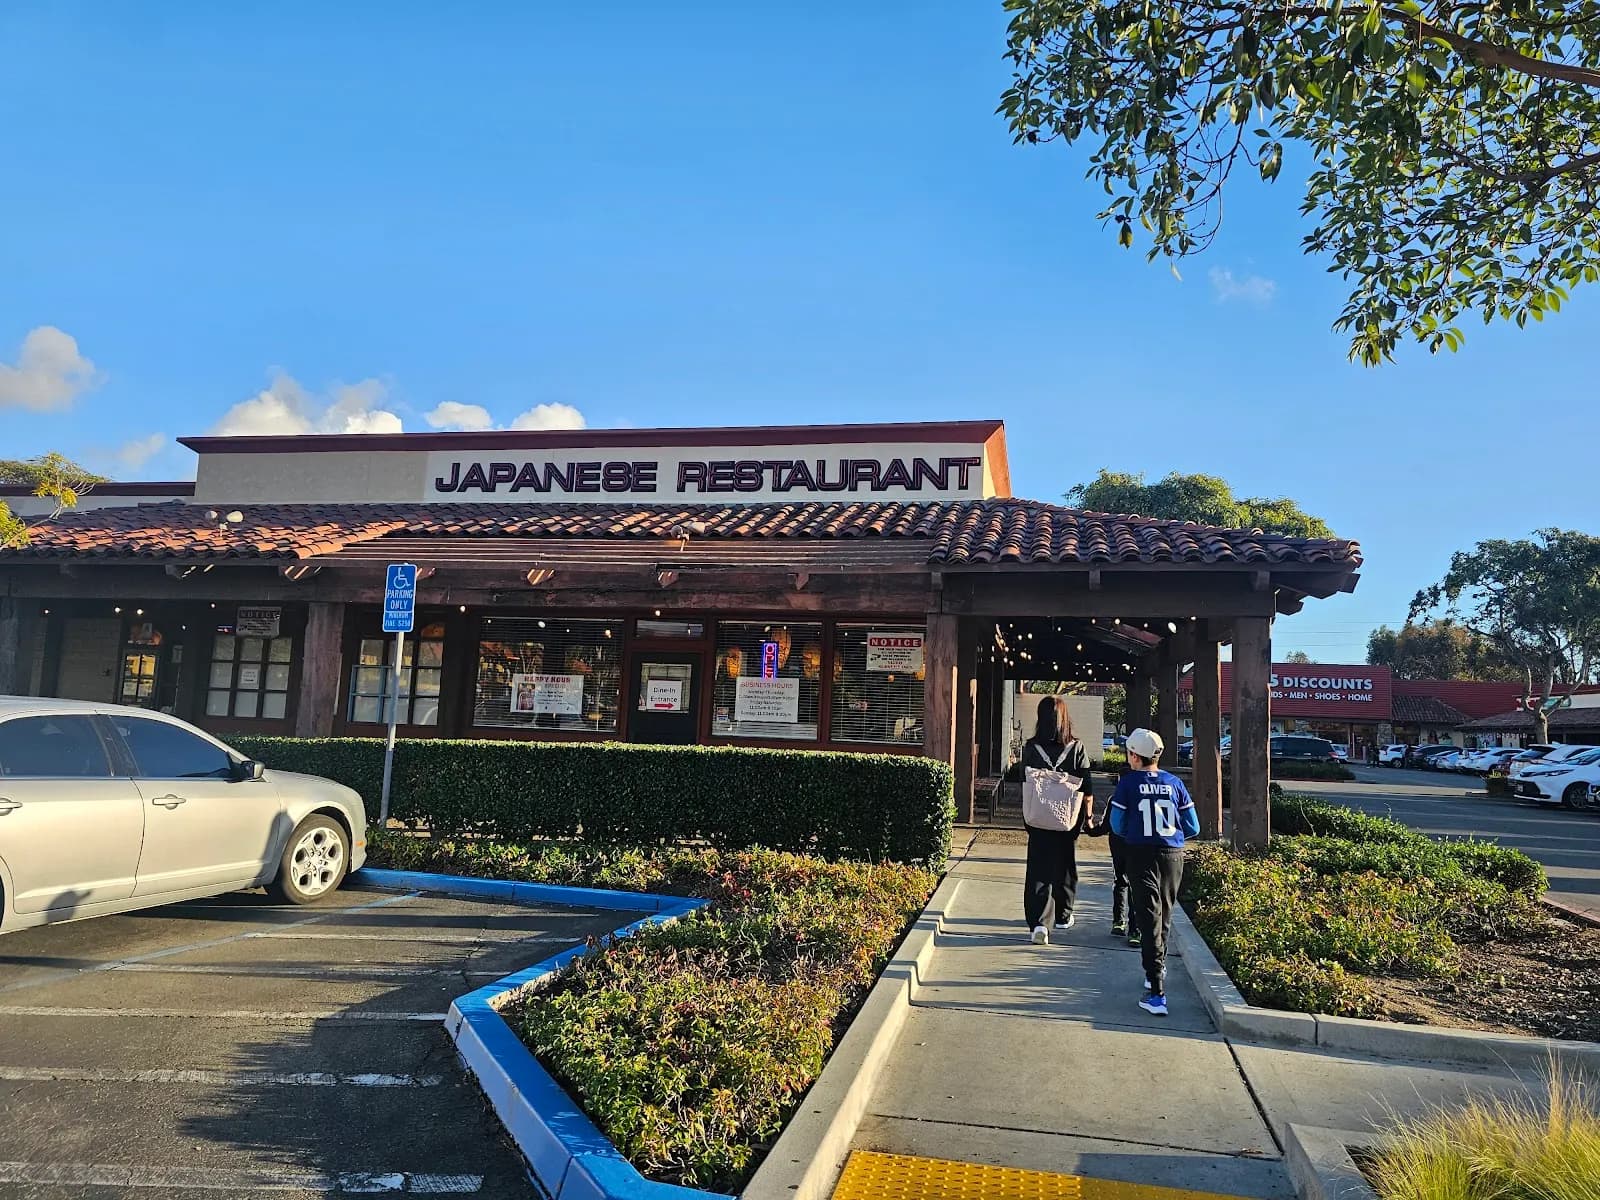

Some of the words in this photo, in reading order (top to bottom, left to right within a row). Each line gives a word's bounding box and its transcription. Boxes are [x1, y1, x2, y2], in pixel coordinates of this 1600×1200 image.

[435, 461, 657, 493] JAPANESE
[677, 456, 981, 492] RESTAURANT
[386, 589, 413, 599] PARKING
[390, 600, 408, 609] ONLY
[871, 638, 920, 647] NOTICE
[1283, 677, 1373, 690] DISCOUNTS
[1289, 691, 1308, 699] MEN
[1314, 692, 1341, 700] SHOES
[1347, 693, 1373, 701] HOME
[1139, 783, 1172, 795] OLIVER
[1138, 799, 1177, 837] 10
